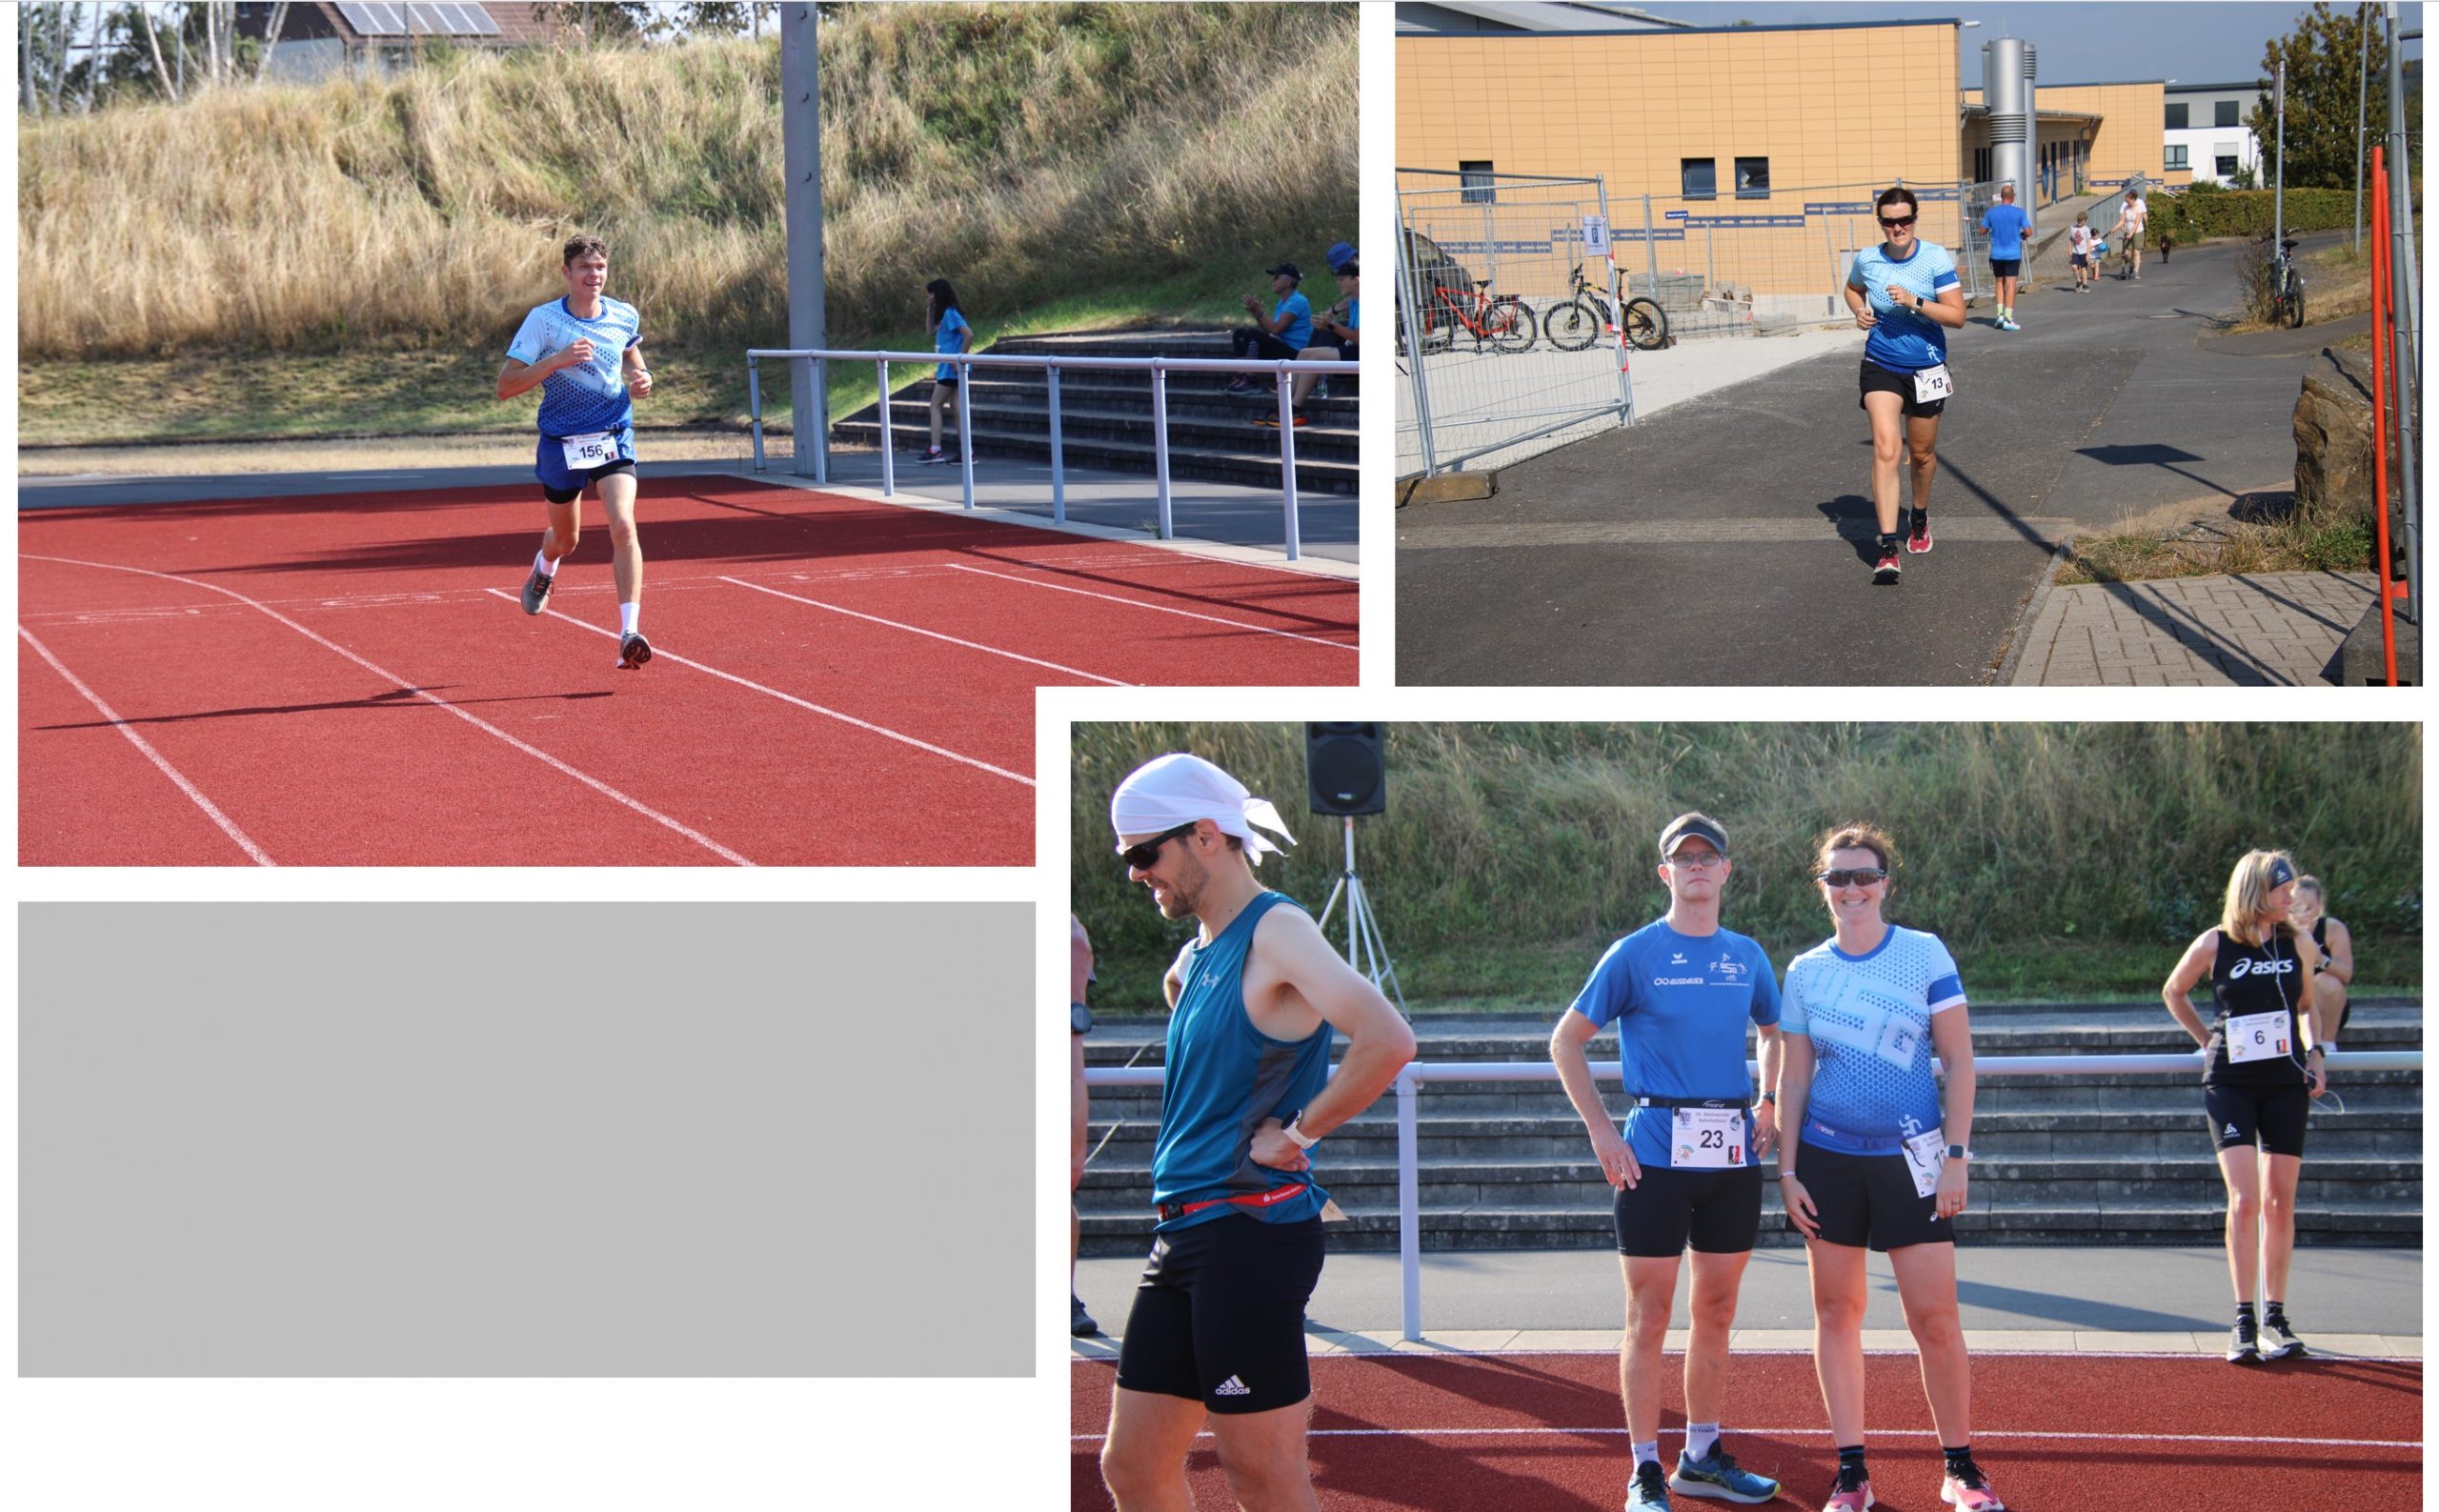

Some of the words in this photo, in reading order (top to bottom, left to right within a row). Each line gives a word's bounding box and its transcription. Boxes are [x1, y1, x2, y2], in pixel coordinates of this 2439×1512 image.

[1931, 377, 1944, 390] 13
[579, 444, 604, 458] 156
[2251, 958, 2294, 976] asics
[2254, 1030, 2266, 1045] 6
[1700, 1129, 1724, 1149] 23
[1215, 1386, 1251, 1396] adidas
